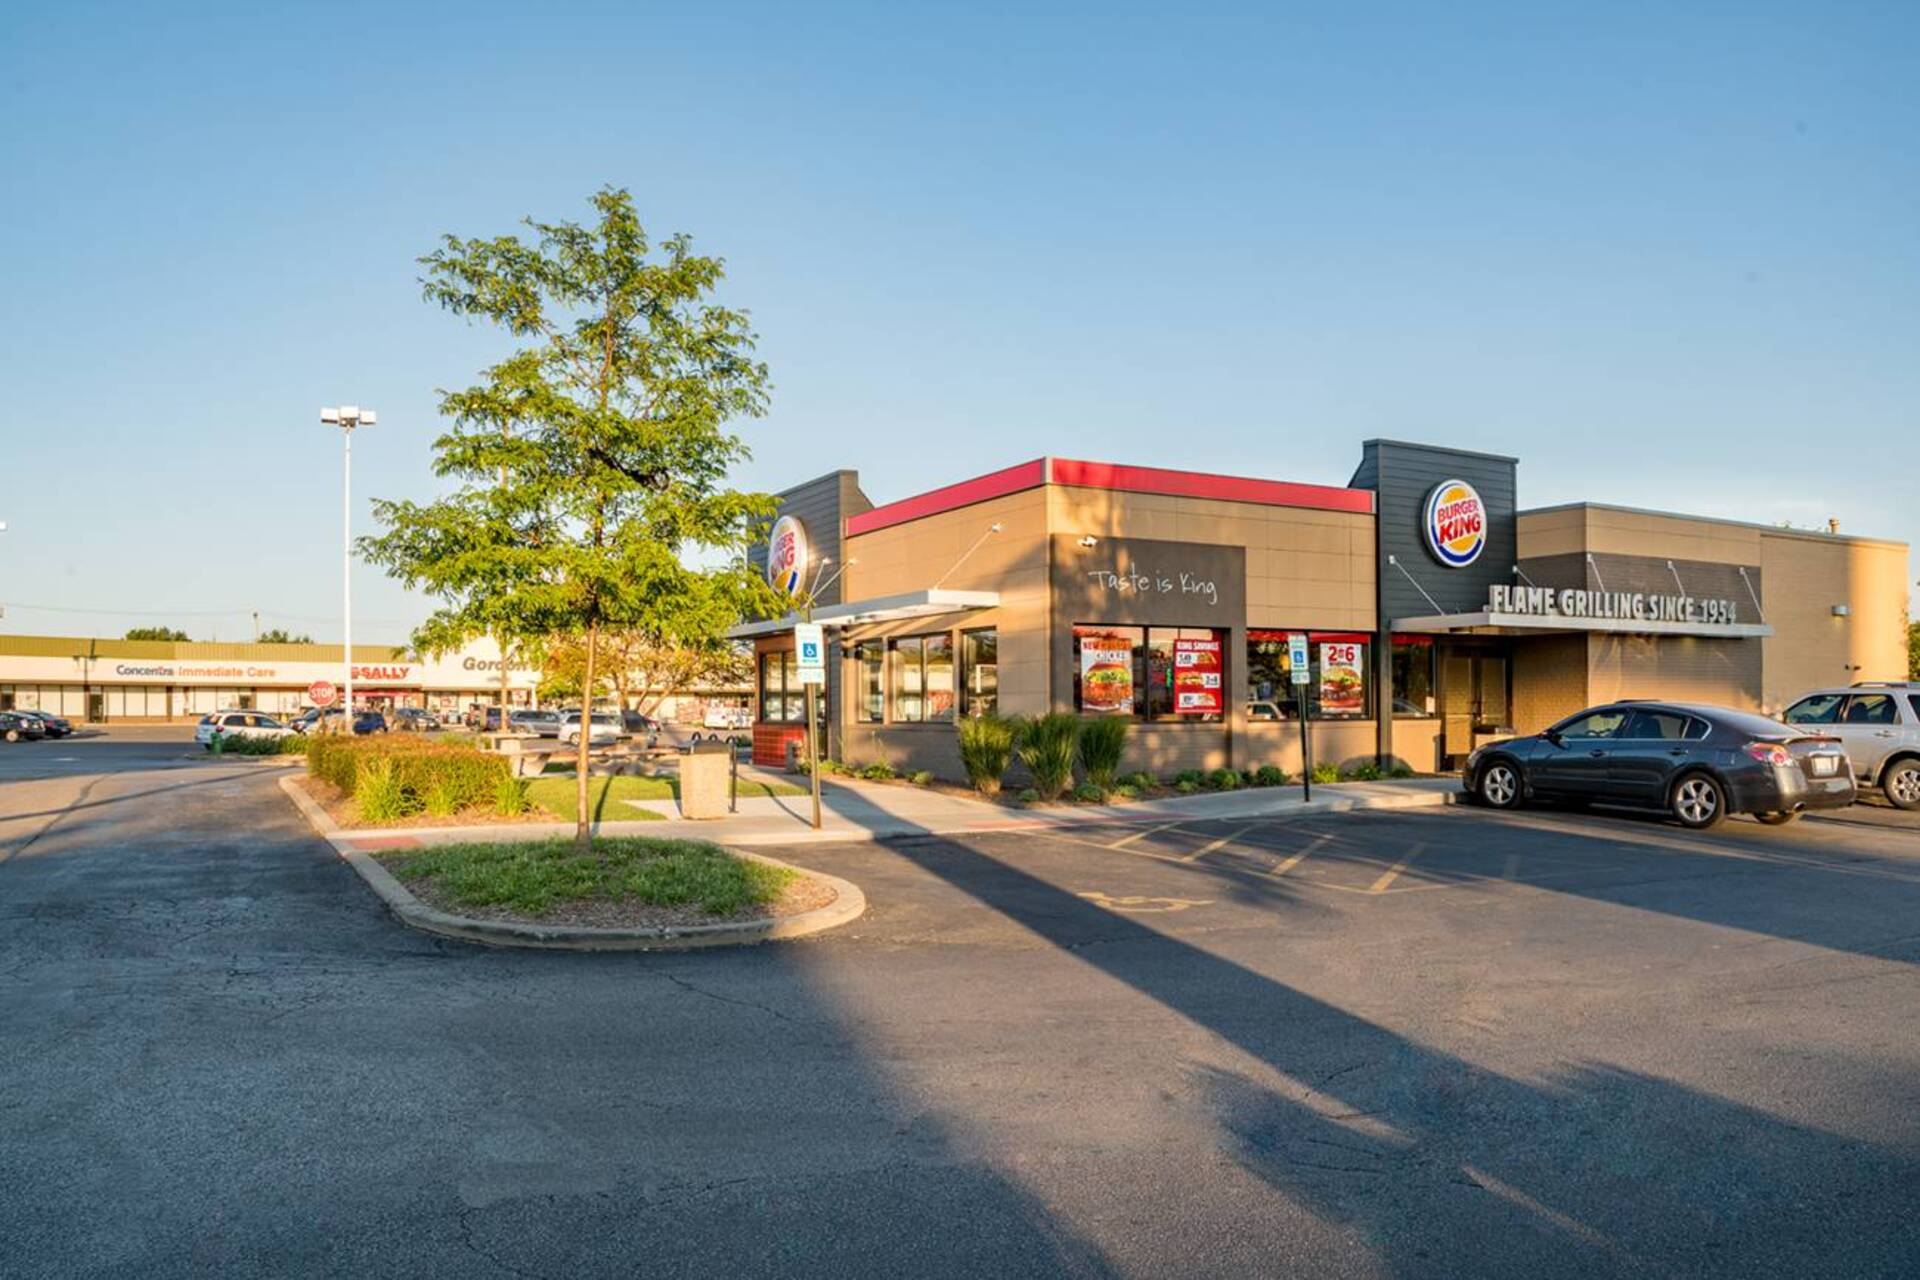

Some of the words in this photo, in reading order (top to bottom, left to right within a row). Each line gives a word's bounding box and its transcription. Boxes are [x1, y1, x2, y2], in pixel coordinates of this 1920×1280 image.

[1438, 500, 1478, 524] BURGER
[1439, 513, 1481, 544] KING
[1088, 562, 1149, 592] Taste
[1155, 570, 1173, 592] is
[1179, 572, 1218, 605] King
[1490, 584, 1555, 614] FLAME
[1559, 588, 1644, 620] GRILLING
[1648, 595, 1694, 622] SINCE
[1701, 600, 1737, 624] 1954
[1328, 645, 1338, 662] 2
[1345, 645, 1355, 662] 6
[116, 665, 174, 677] Concentra
[178, 666, 243, 678] Immediate
[247, 667, 276, 678] Care
[361, 667, 410, 680] SALLY
[310, 688, 333, 700] STOP
